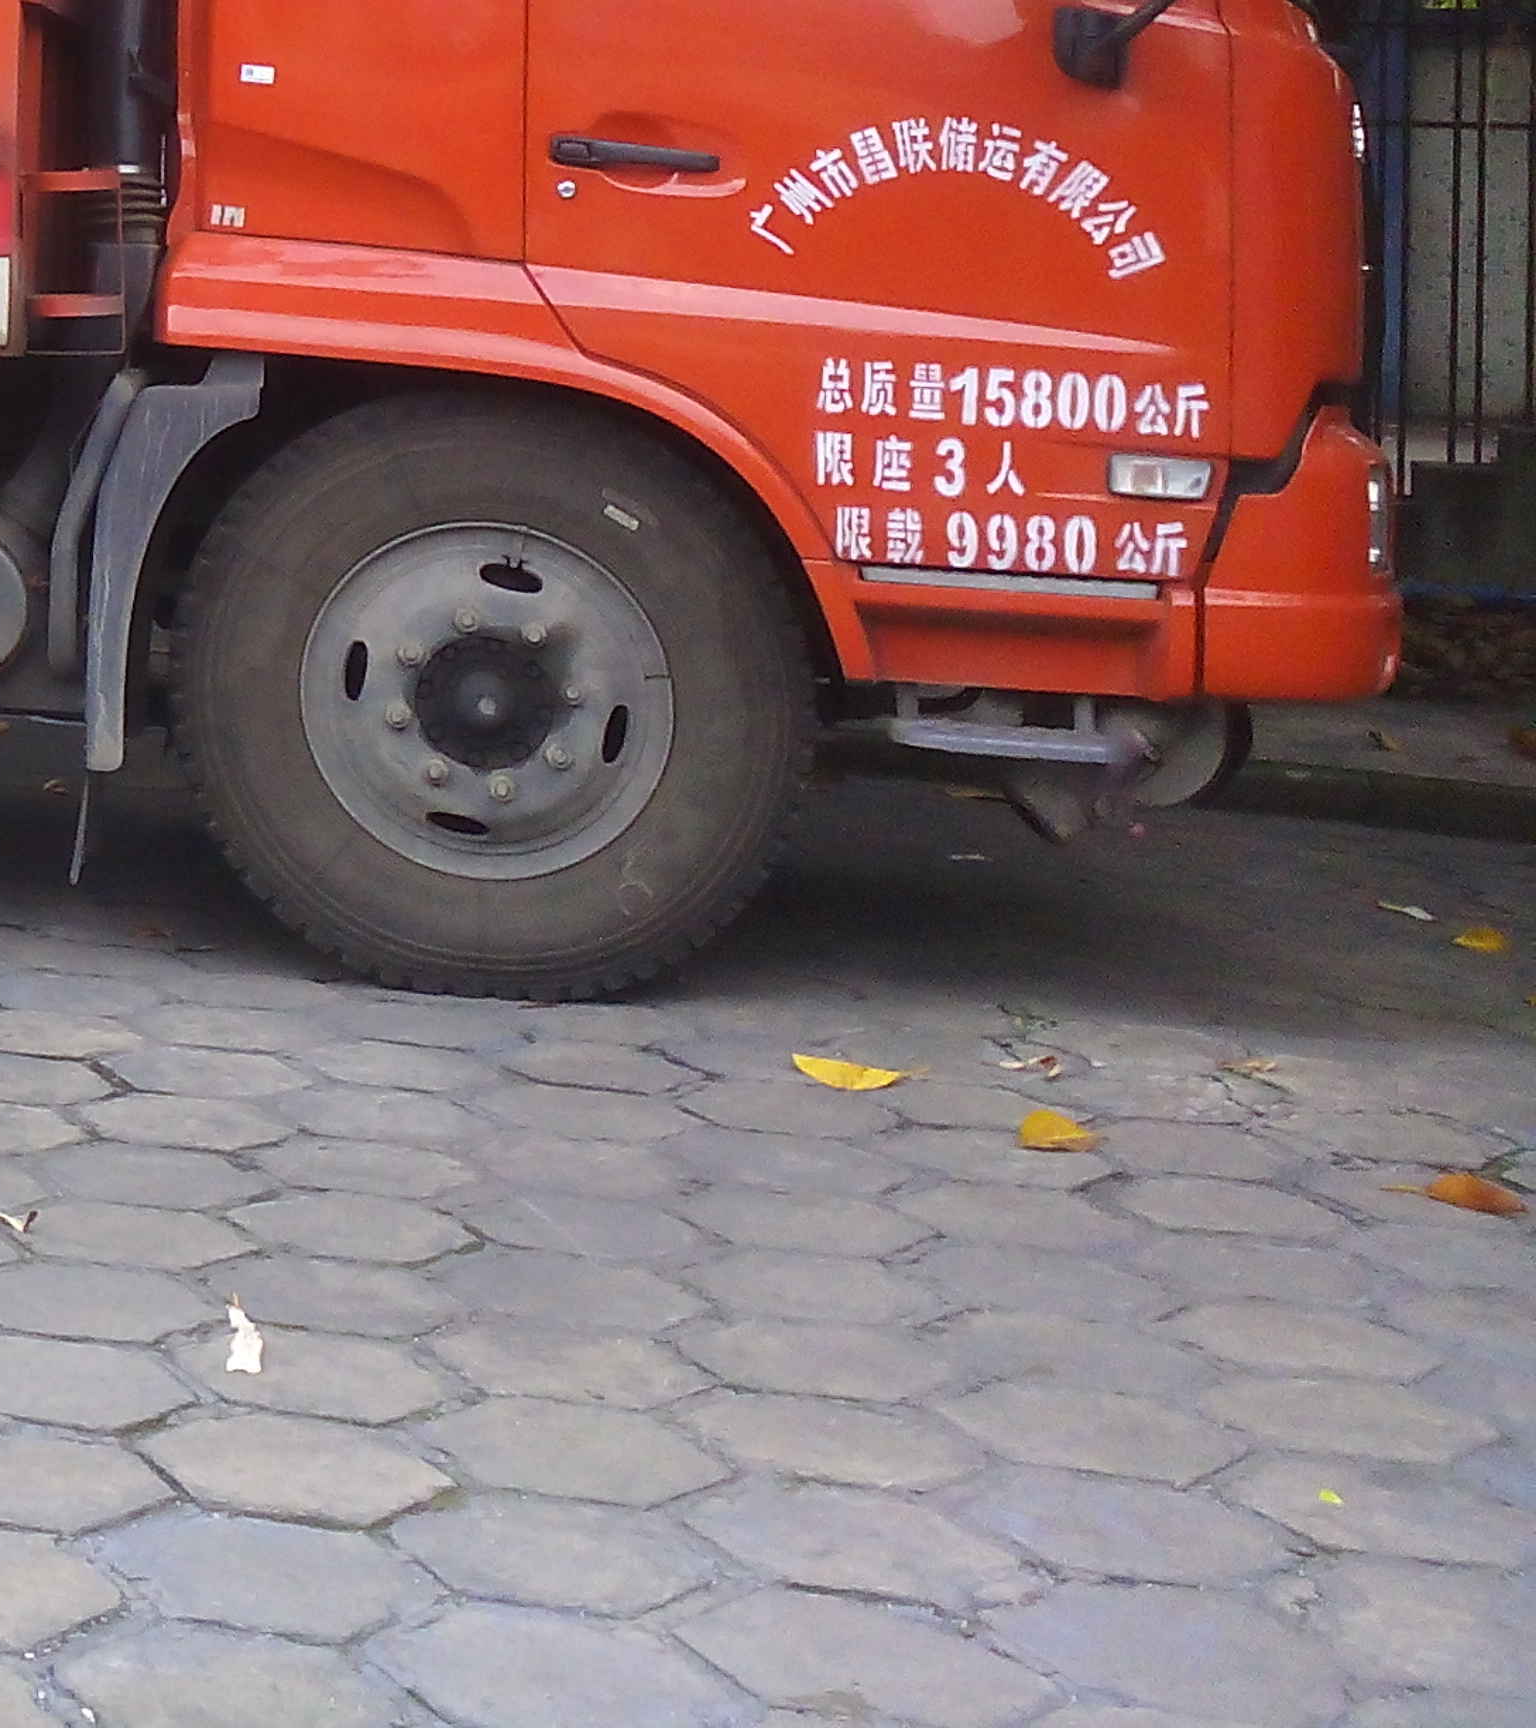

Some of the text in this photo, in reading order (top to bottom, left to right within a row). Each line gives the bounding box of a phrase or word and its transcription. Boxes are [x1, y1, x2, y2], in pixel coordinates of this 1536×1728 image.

[749, 116, 1167, 280] 广州市昌联储运有限公司
